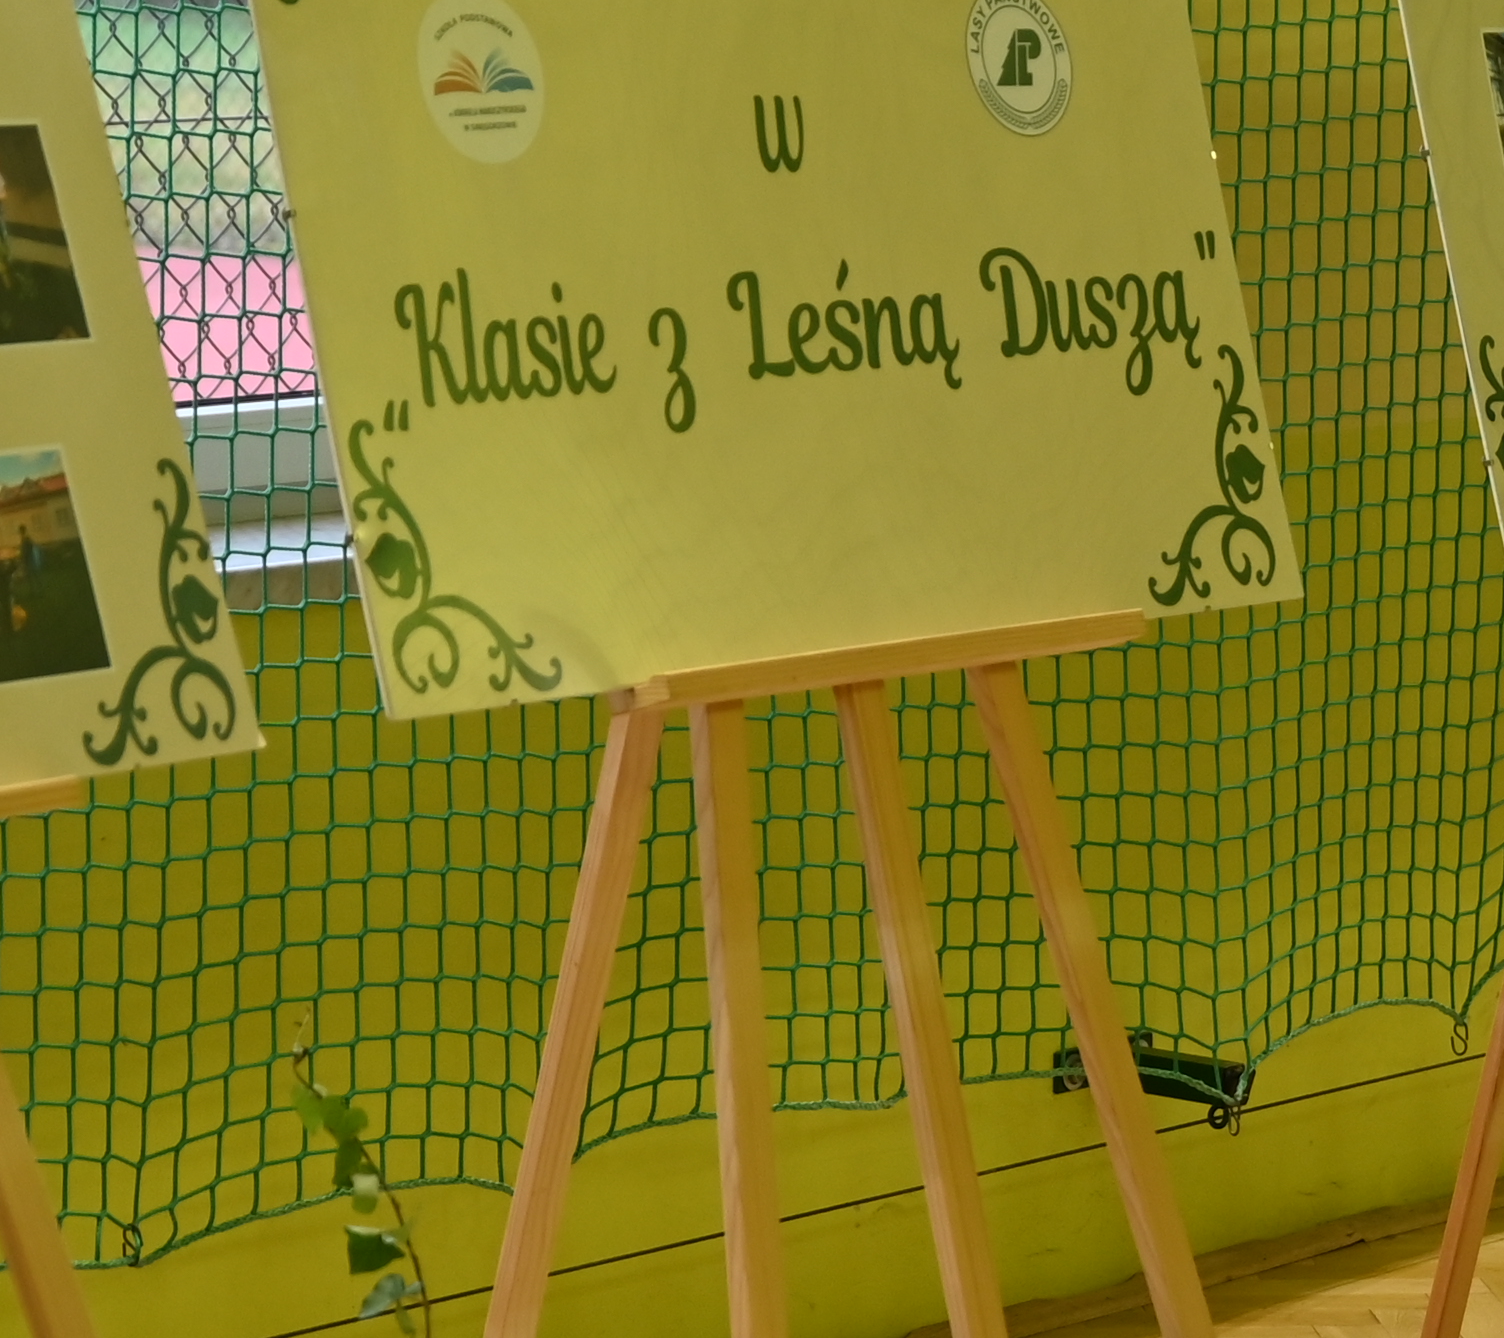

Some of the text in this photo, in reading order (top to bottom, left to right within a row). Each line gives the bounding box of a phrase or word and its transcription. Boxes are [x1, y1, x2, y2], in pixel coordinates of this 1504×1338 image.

[970, 6, 987, 54] LASY
[753, 94, 805, 174] w
[647, 307, 697, 434] z
[726, 258, 963, 391] Leśną
